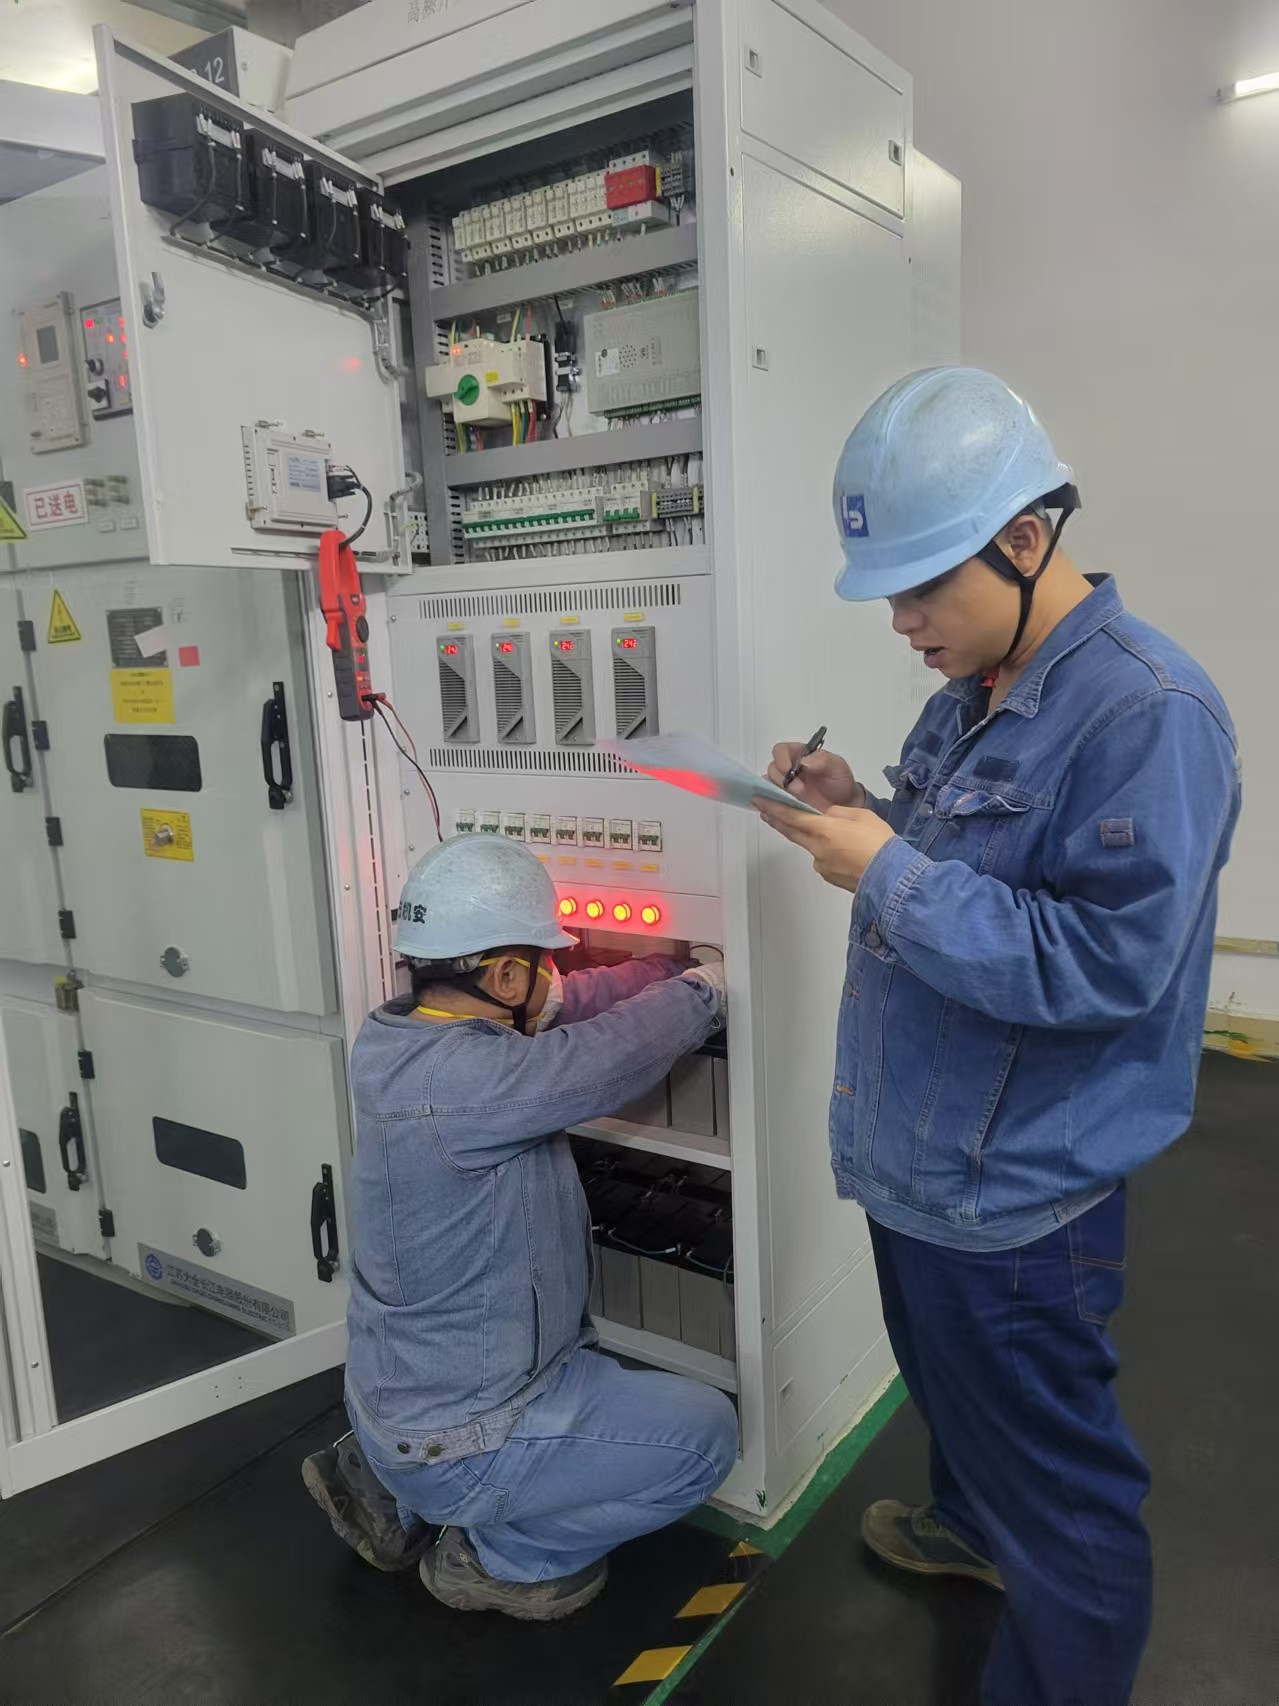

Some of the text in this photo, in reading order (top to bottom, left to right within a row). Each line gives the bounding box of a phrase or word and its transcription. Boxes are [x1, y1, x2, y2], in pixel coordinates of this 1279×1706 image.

[204, 57, 225, 84] 12
[34, 491, 78, 519] 已送电
